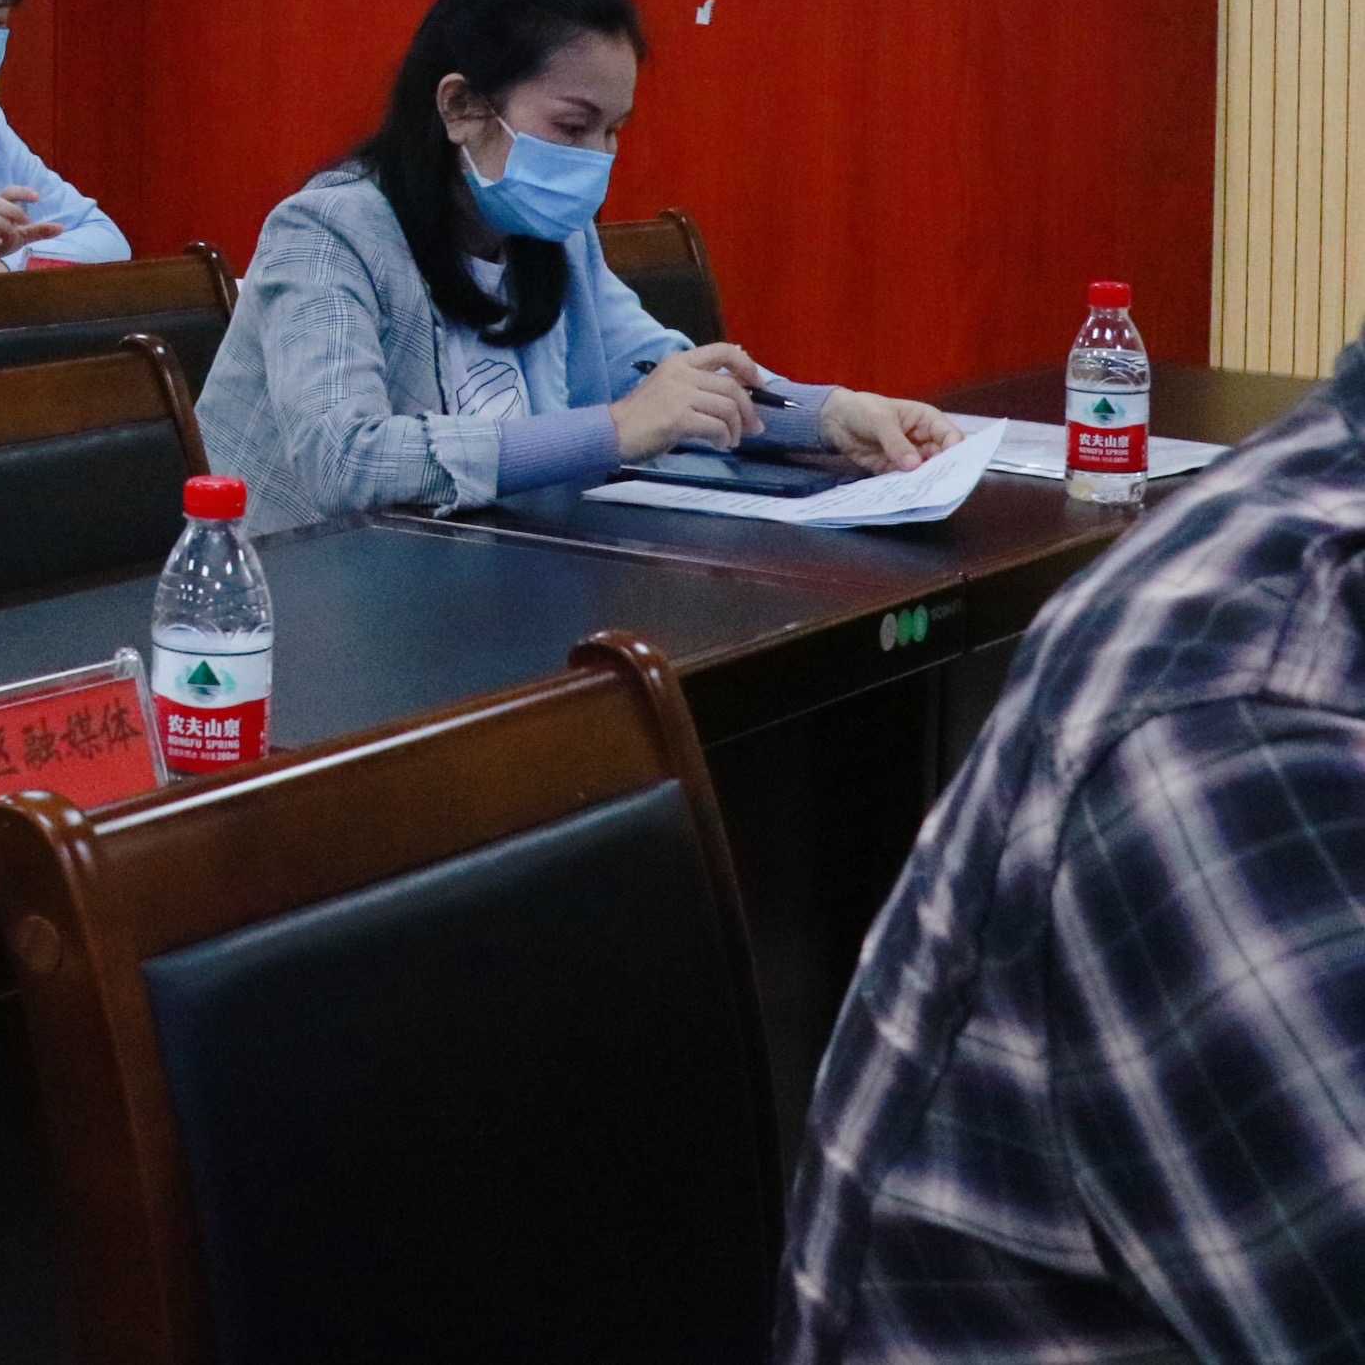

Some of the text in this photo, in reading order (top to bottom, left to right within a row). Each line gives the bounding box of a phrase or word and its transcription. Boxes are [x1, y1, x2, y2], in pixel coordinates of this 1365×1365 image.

[1079, 433, 1129, 448] 农夫山泉
[168, 715, 241, 738] 农夫山泉
[167, 735, 240, 750] NONGFU SPRING
